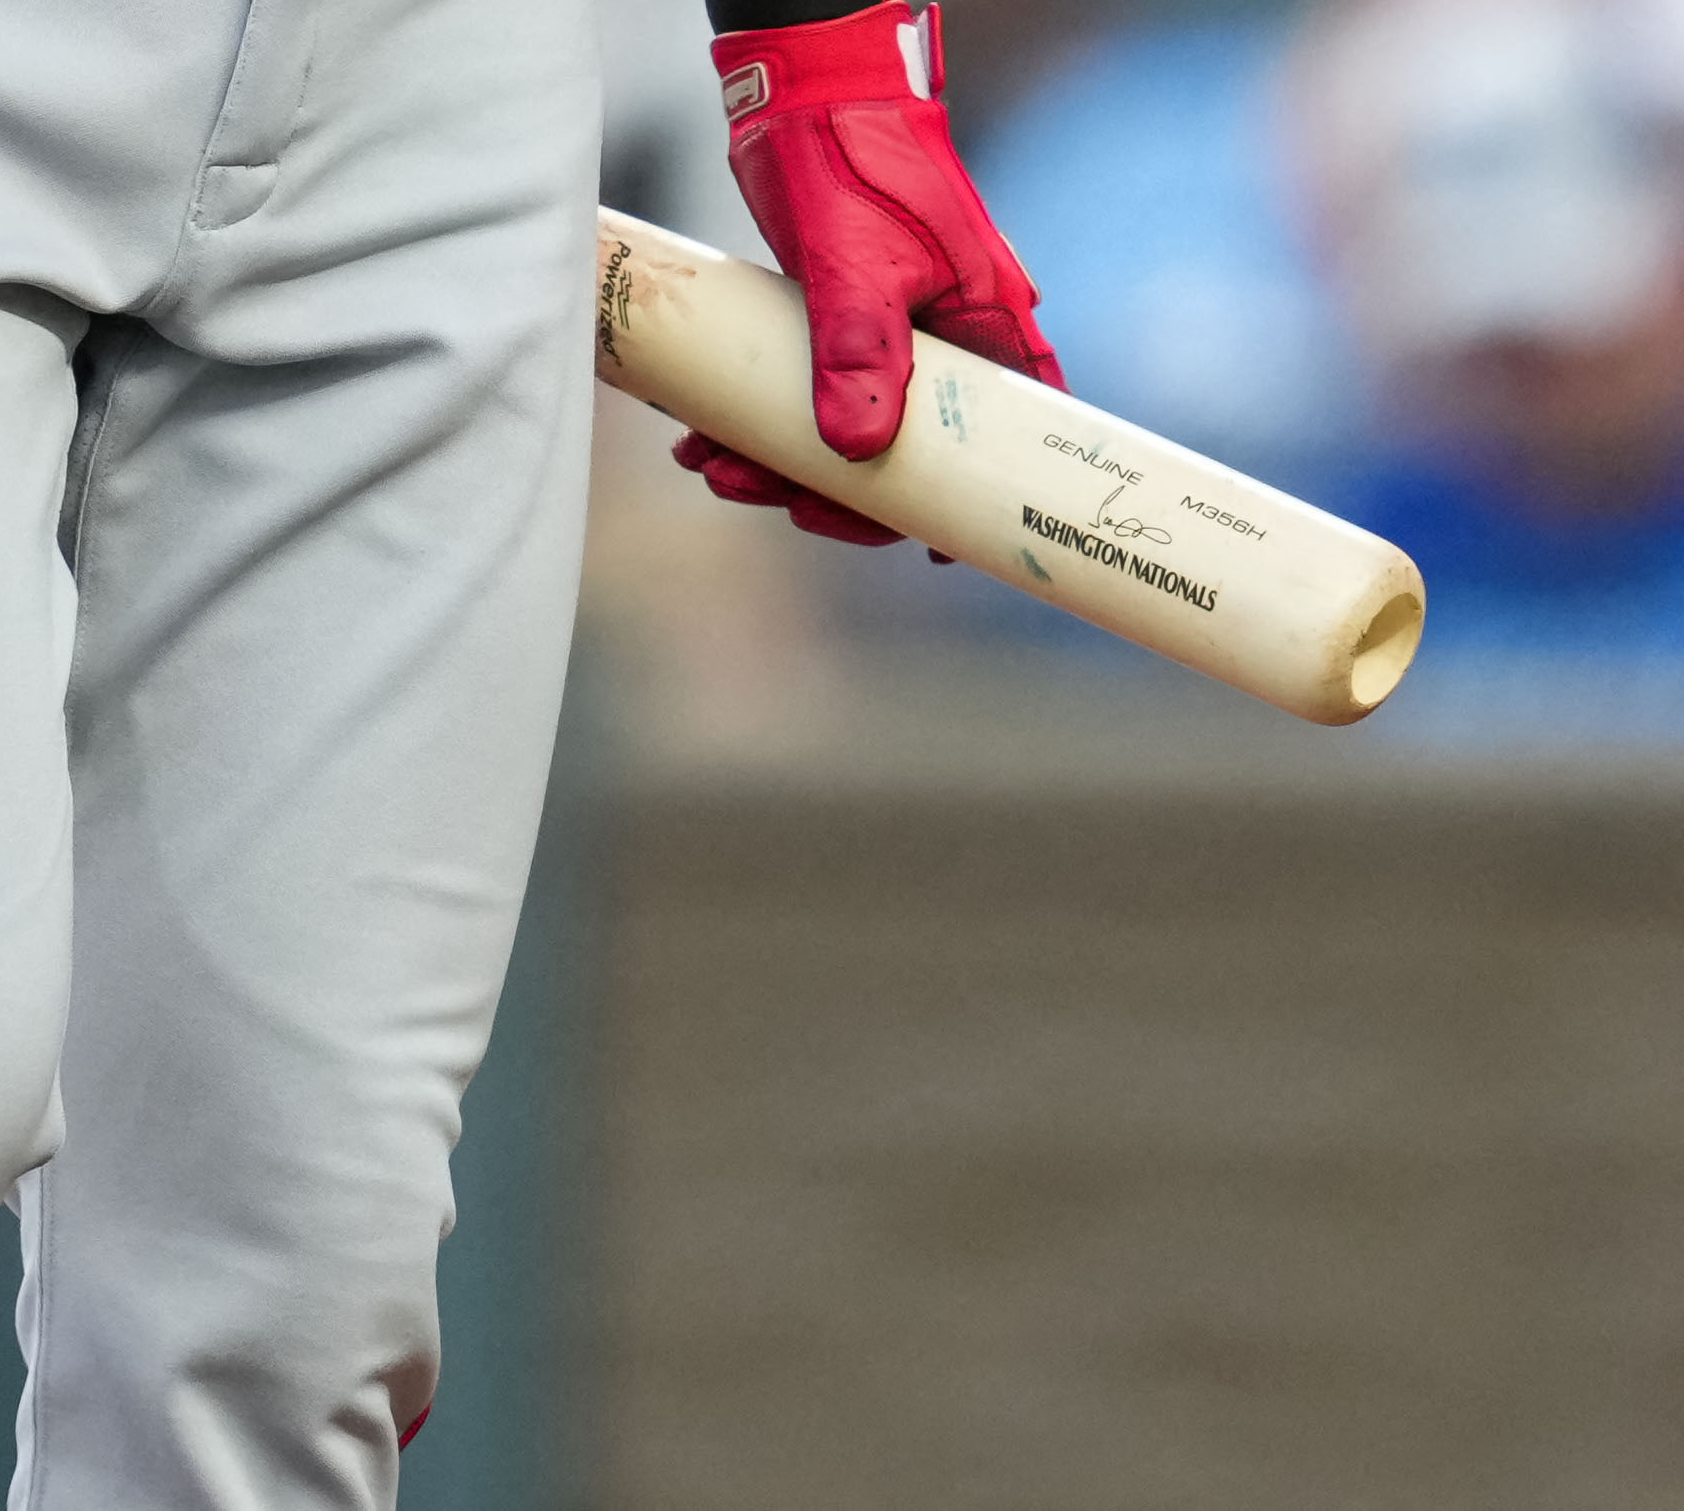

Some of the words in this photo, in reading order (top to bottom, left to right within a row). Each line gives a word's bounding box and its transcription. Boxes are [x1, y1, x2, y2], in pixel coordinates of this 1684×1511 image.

[1043, 434, 1144, 485] GENUINE
[1180, 496, 1268, 540] M356H
[1022, 505, 1128, 572] WASHINGTON
[1128, 554, 1217, 611] NATIONALS
